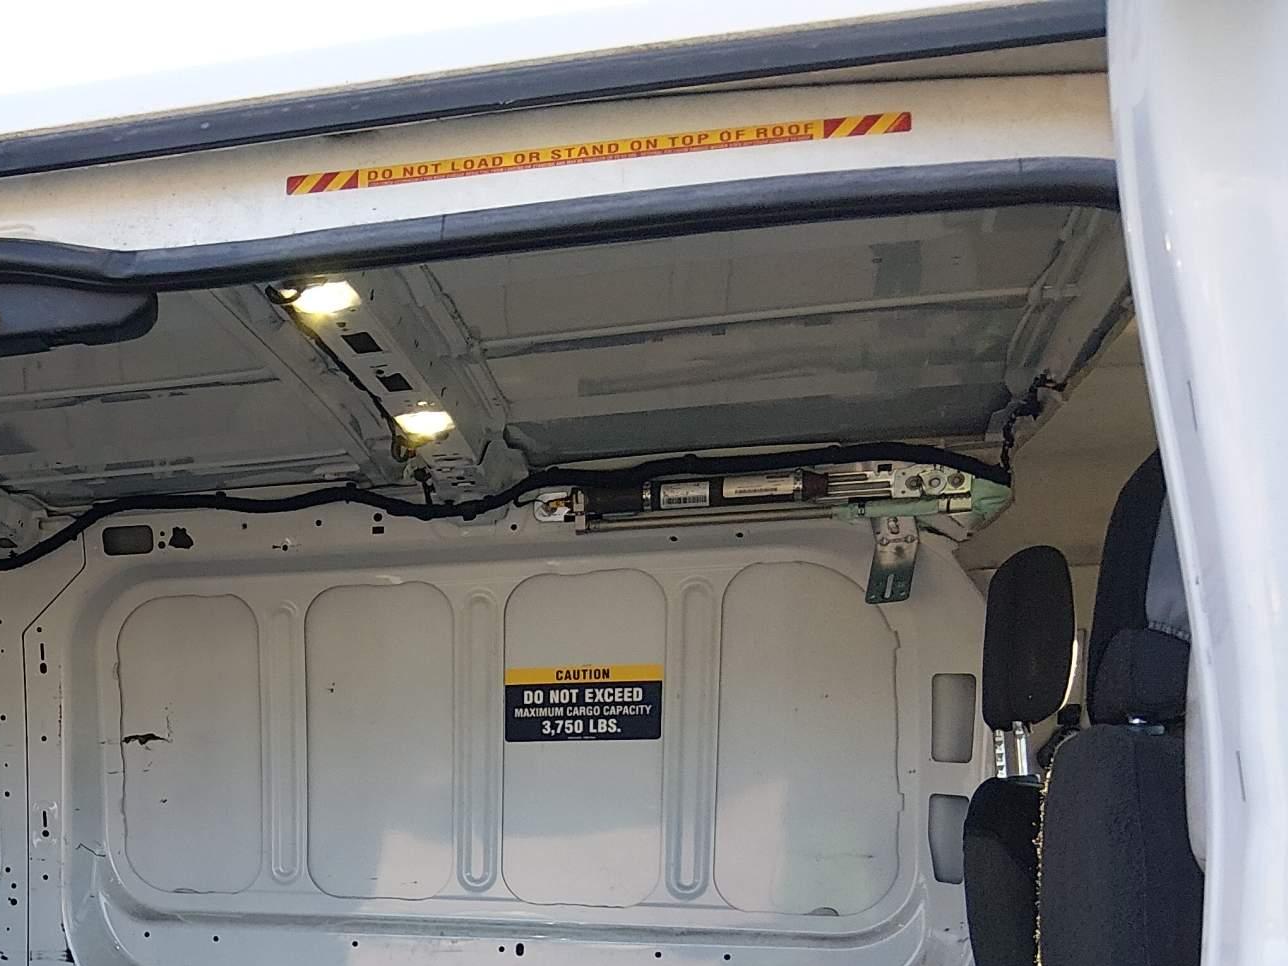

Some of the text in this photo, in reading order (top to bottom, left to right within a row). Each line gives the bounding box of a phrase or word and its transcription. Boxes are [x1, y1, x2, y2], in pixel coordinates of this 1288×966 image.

[367, 123, 815, 181] DO NOT LOAD OR STAND ON TOP OF ROOF
[555, 668, 610, 681] CAUTION
[523, 687, 643, 705] DO NOT EXCEED
[514, 704, 652, 718] MAXIMUM CARGO CAPACITY
[541, 719, 622, 736] 3,750 LBS.
